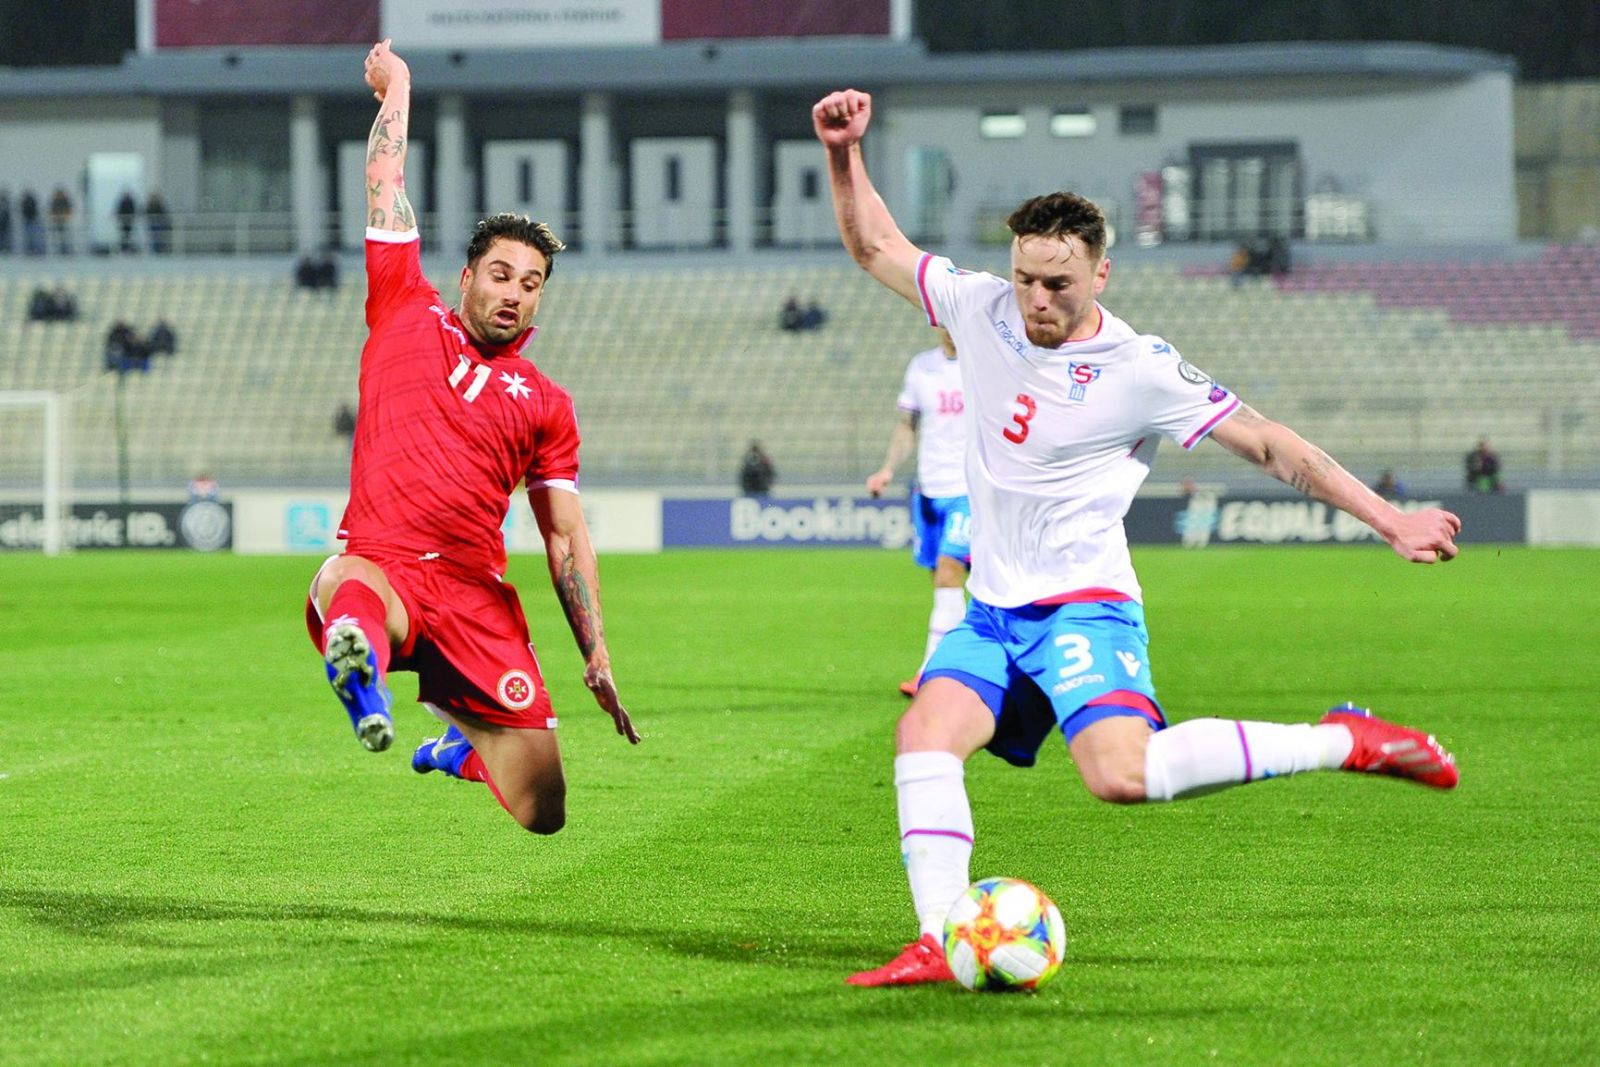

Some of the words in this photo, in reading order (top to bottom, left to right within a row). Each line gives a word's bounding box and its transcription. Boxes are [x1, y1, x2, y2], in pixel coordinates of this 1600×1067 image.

[448, 354, 493, 404] 11
[937, 391, 965, 415] 16
[1003, 393, 1037, 444] 3
[0, 510, 124, 546] eletric
[730, 497, 914, 549] Booking
[1054, 633, 1094, 678] 3
